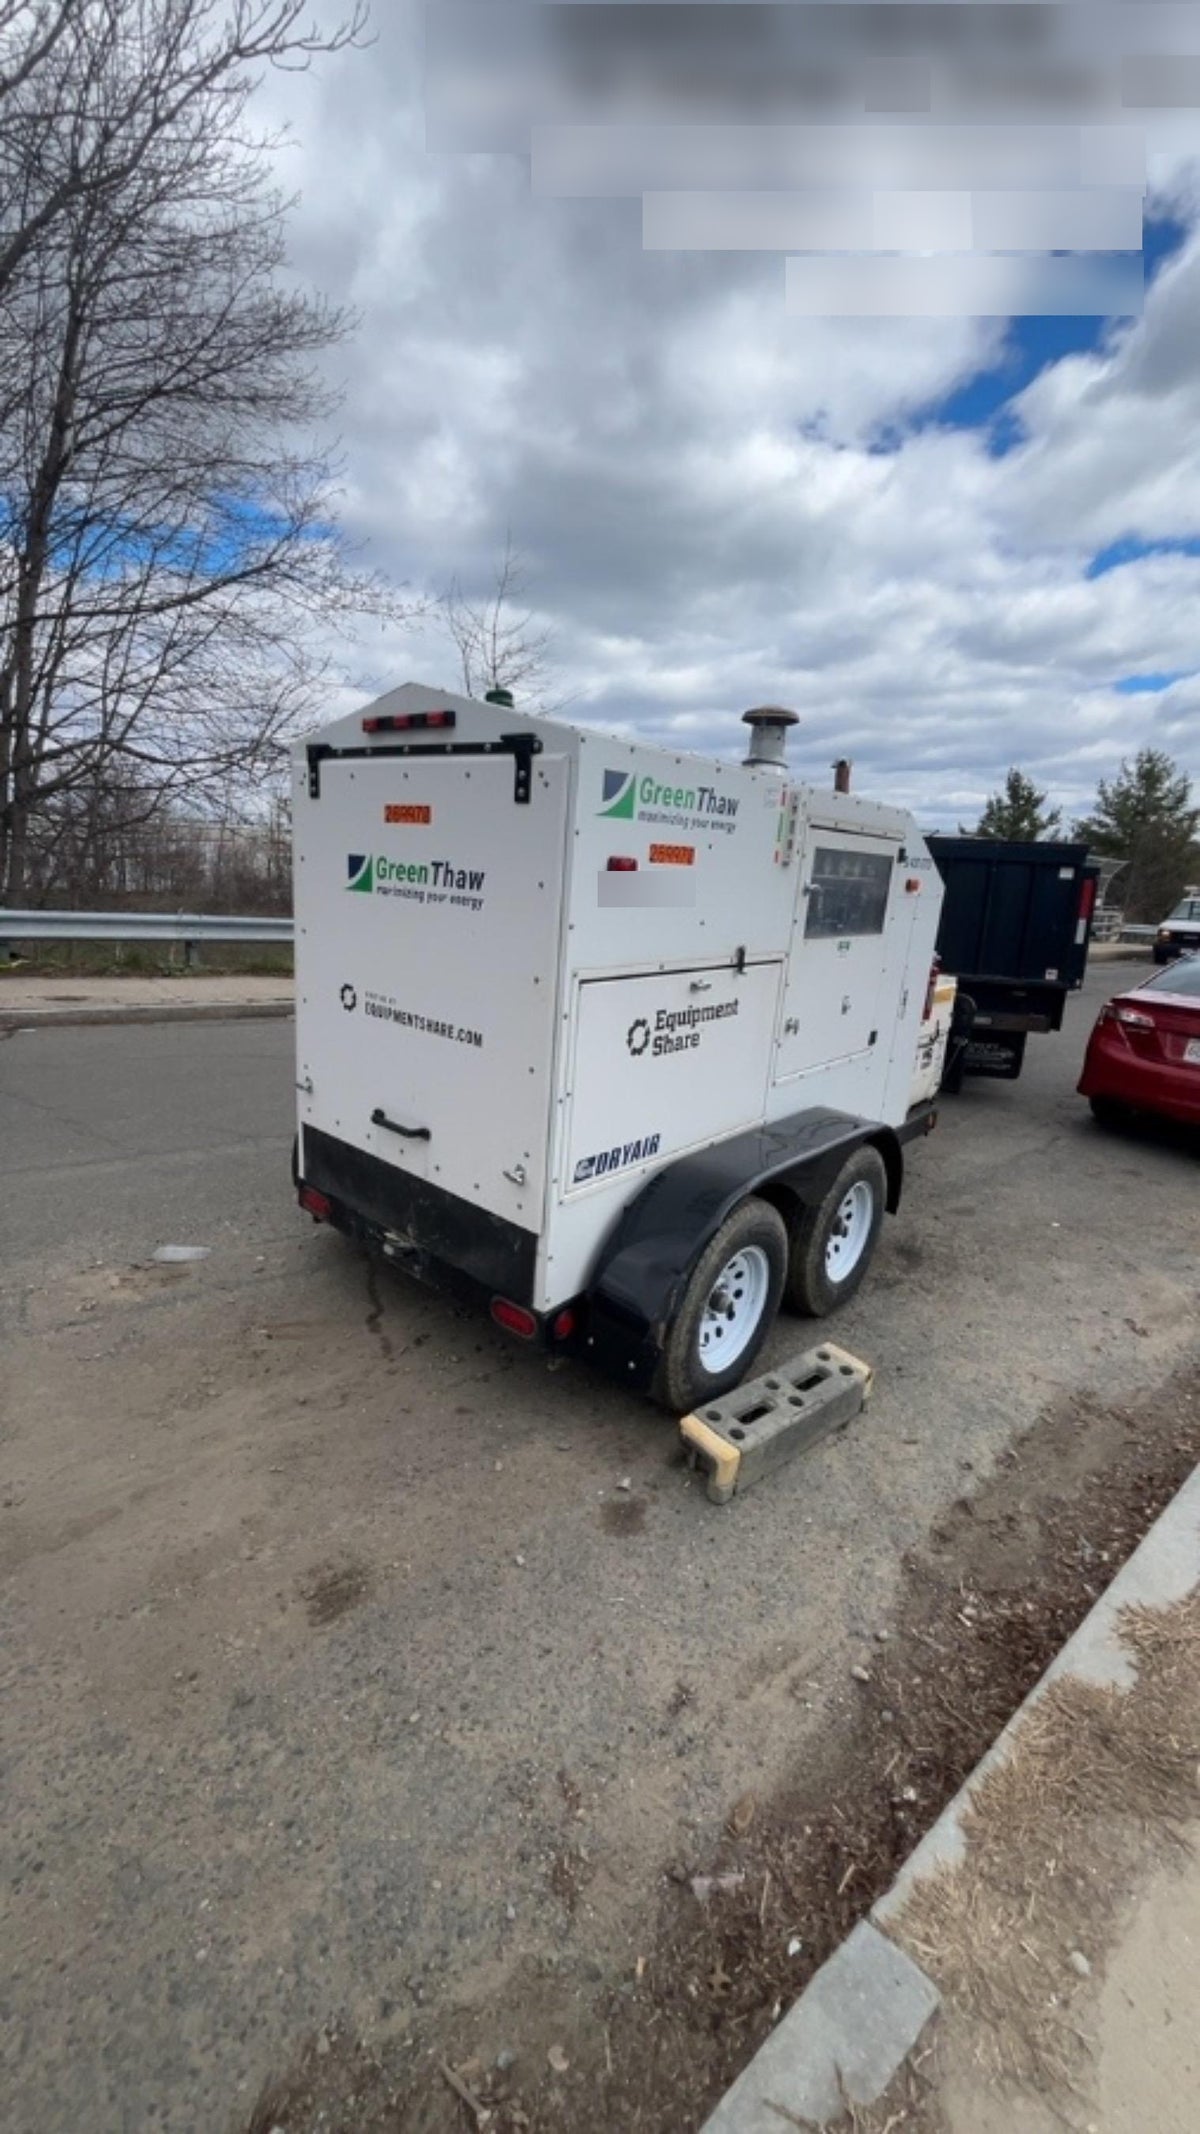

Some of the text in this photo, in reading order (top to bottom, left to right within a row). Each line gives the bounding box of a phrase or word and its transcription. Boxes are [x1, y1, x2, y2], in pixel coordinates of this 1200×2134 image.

[364, 1001, 483, 1048] EQUIPMENTSHARE.COM
[654, 998, 739, 1032] Equipment
[652, 1033, 700, 1057] Share
[595, 1133, 661, 1176] DRYAIR
